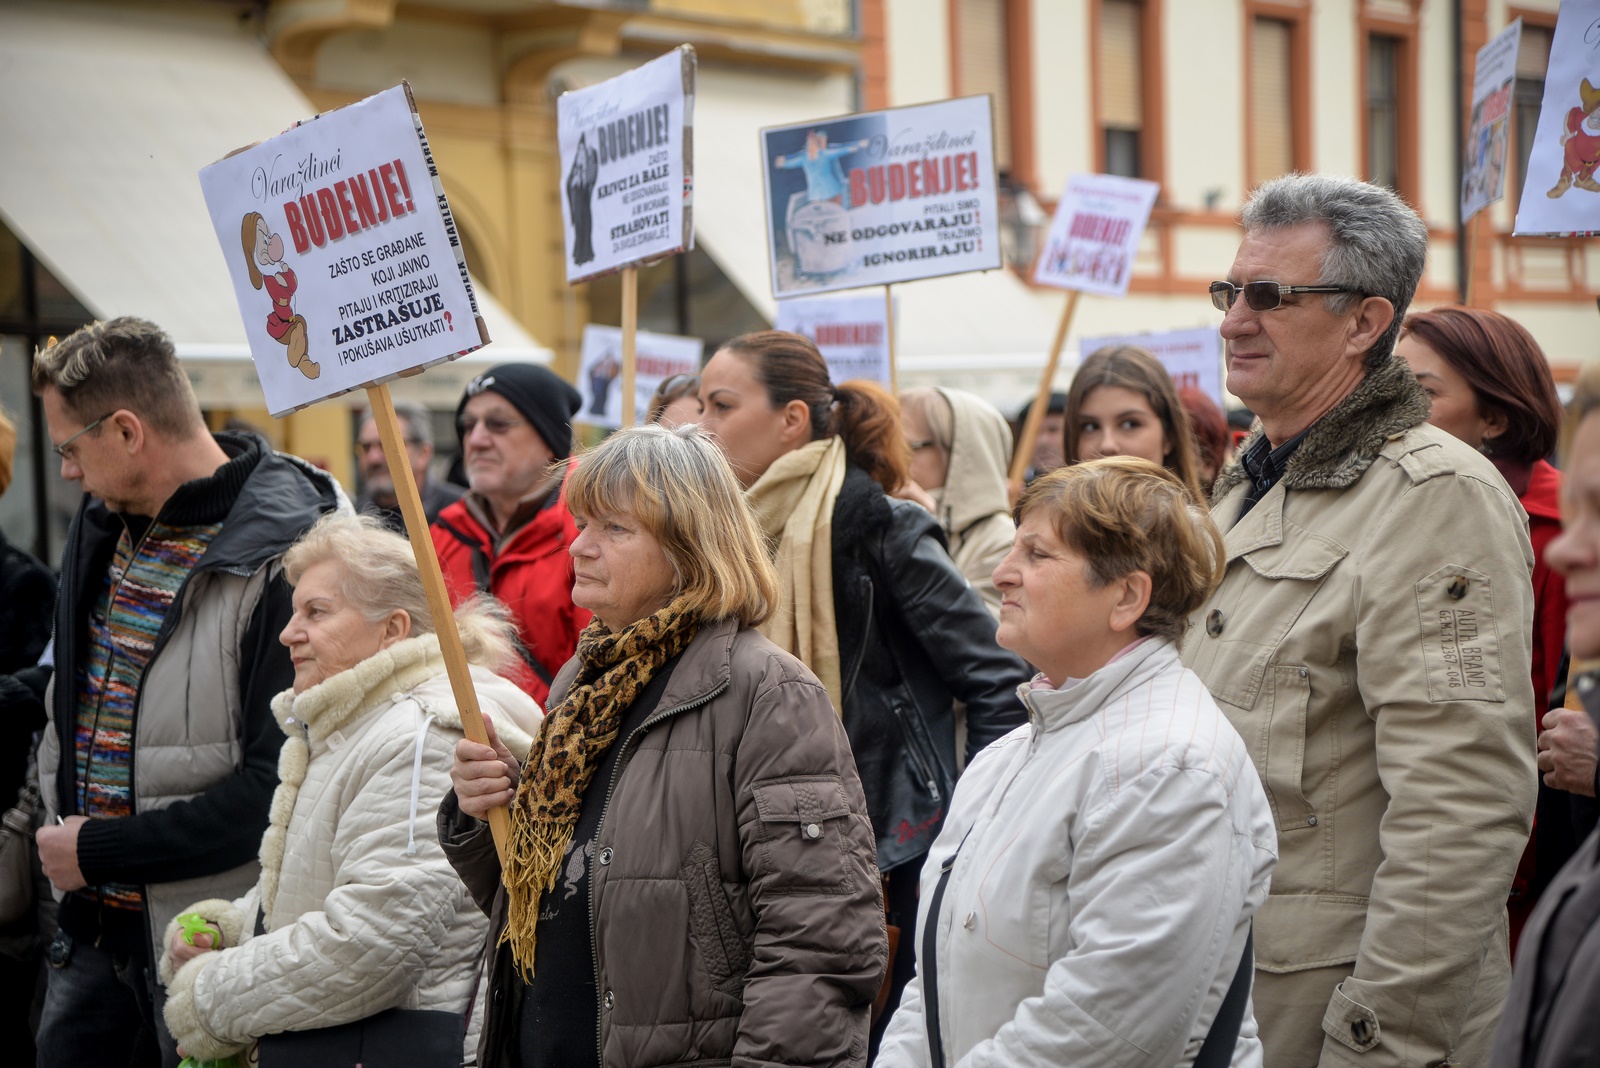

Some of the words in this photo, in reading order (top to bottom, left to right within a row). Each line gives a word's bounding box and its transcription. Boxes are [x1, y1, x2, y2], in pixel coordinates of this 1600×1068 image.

[251, 148, 343, 204] Varaždinci
[283, 159, 415, 255] BUĐENJE!
[437, 194, 460, 247] MARLEX
[329, 256, 360, 279] ZAŠTO
[361, 250, 376, 267] SE
[377, 232, 426, 261] GRAĐANE
[824, 230, 847, 245] NE
[371, 266, 396, 286] KOJI
[398, 254, 430, 278] JAVNO
[332, 292, 444, 346] ZASTRAŠUJE
[339, 296, 372, 320] PITAJU
[372, 295, 378, 308] I
[377, 273, 439, 306] KRITIZIRAJU
[338, 352, 343, 366] I
[343, 335, 396, 365] POKUŠAVA
[1461, 647, 1486, 688] BRAND
